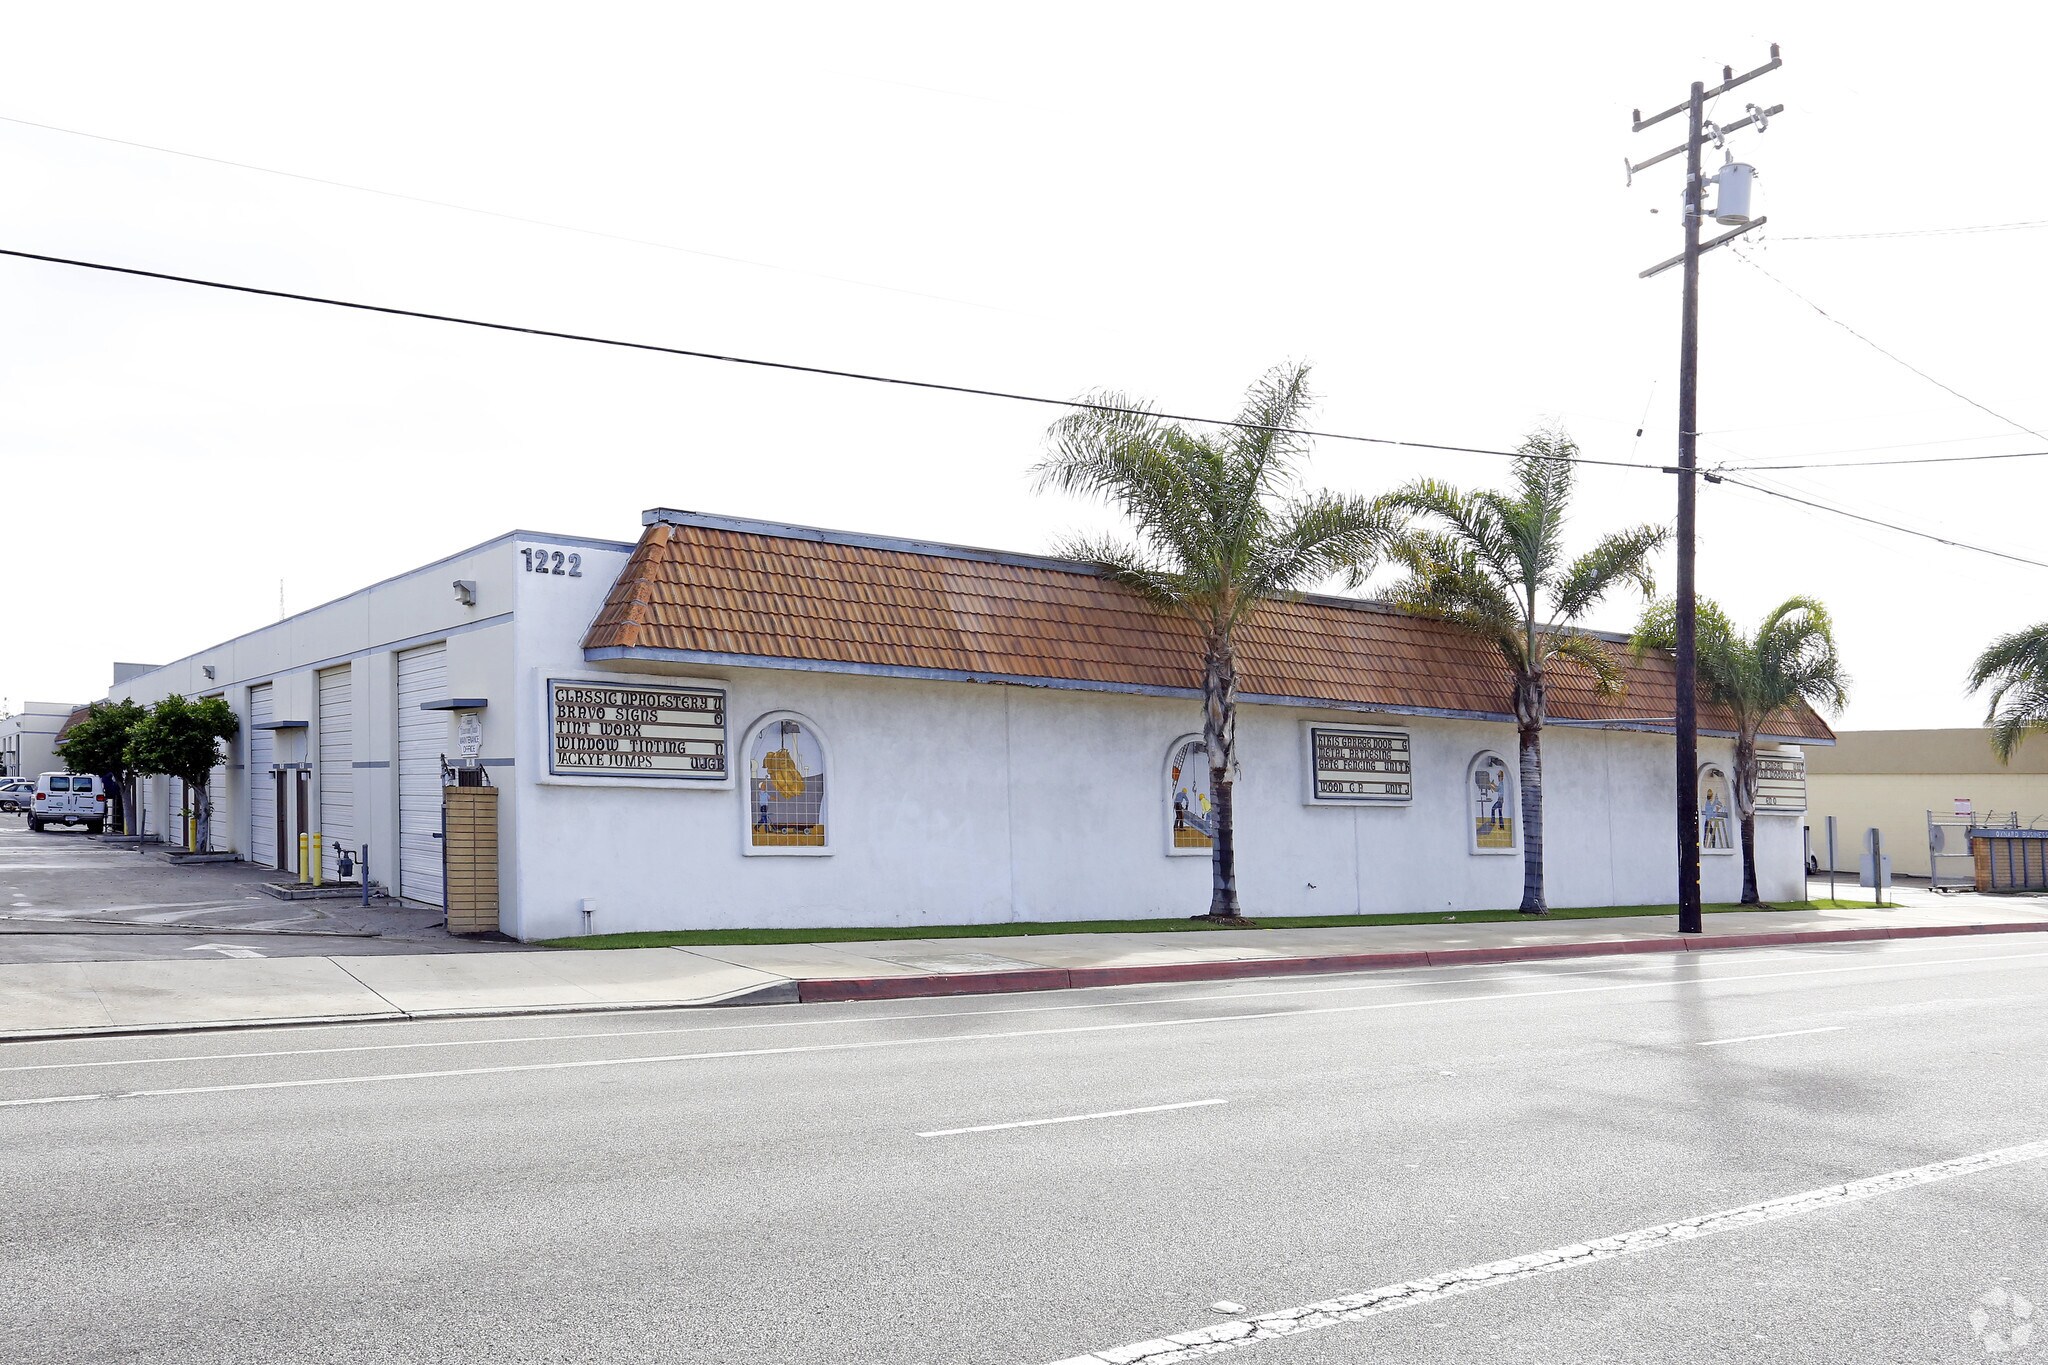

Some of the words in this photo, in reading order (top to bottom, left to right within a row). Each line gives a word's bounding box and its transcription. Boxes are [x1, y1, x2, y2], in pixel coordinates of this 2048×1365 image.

[521, 548, 582, 577] 1222
[555, 689, 617, 704] CLASSIC
[621, 692, 708, 709] UPHOLSTERY
[557, 705, 605, 719] BRAVO
[615, 707, 658, 722] SIGNS
[557, 721, 590, 734] TINT
[600, 723, 641, 736] WORX
[557, 736, 619, 751] WINDOW
[630, 740, 686, 754] TINTING
[1373, 739, 1393, 749] DOOR
[557, 752, 604, 766] JACKYE
[608, 754, 653, 767] JUMPS
